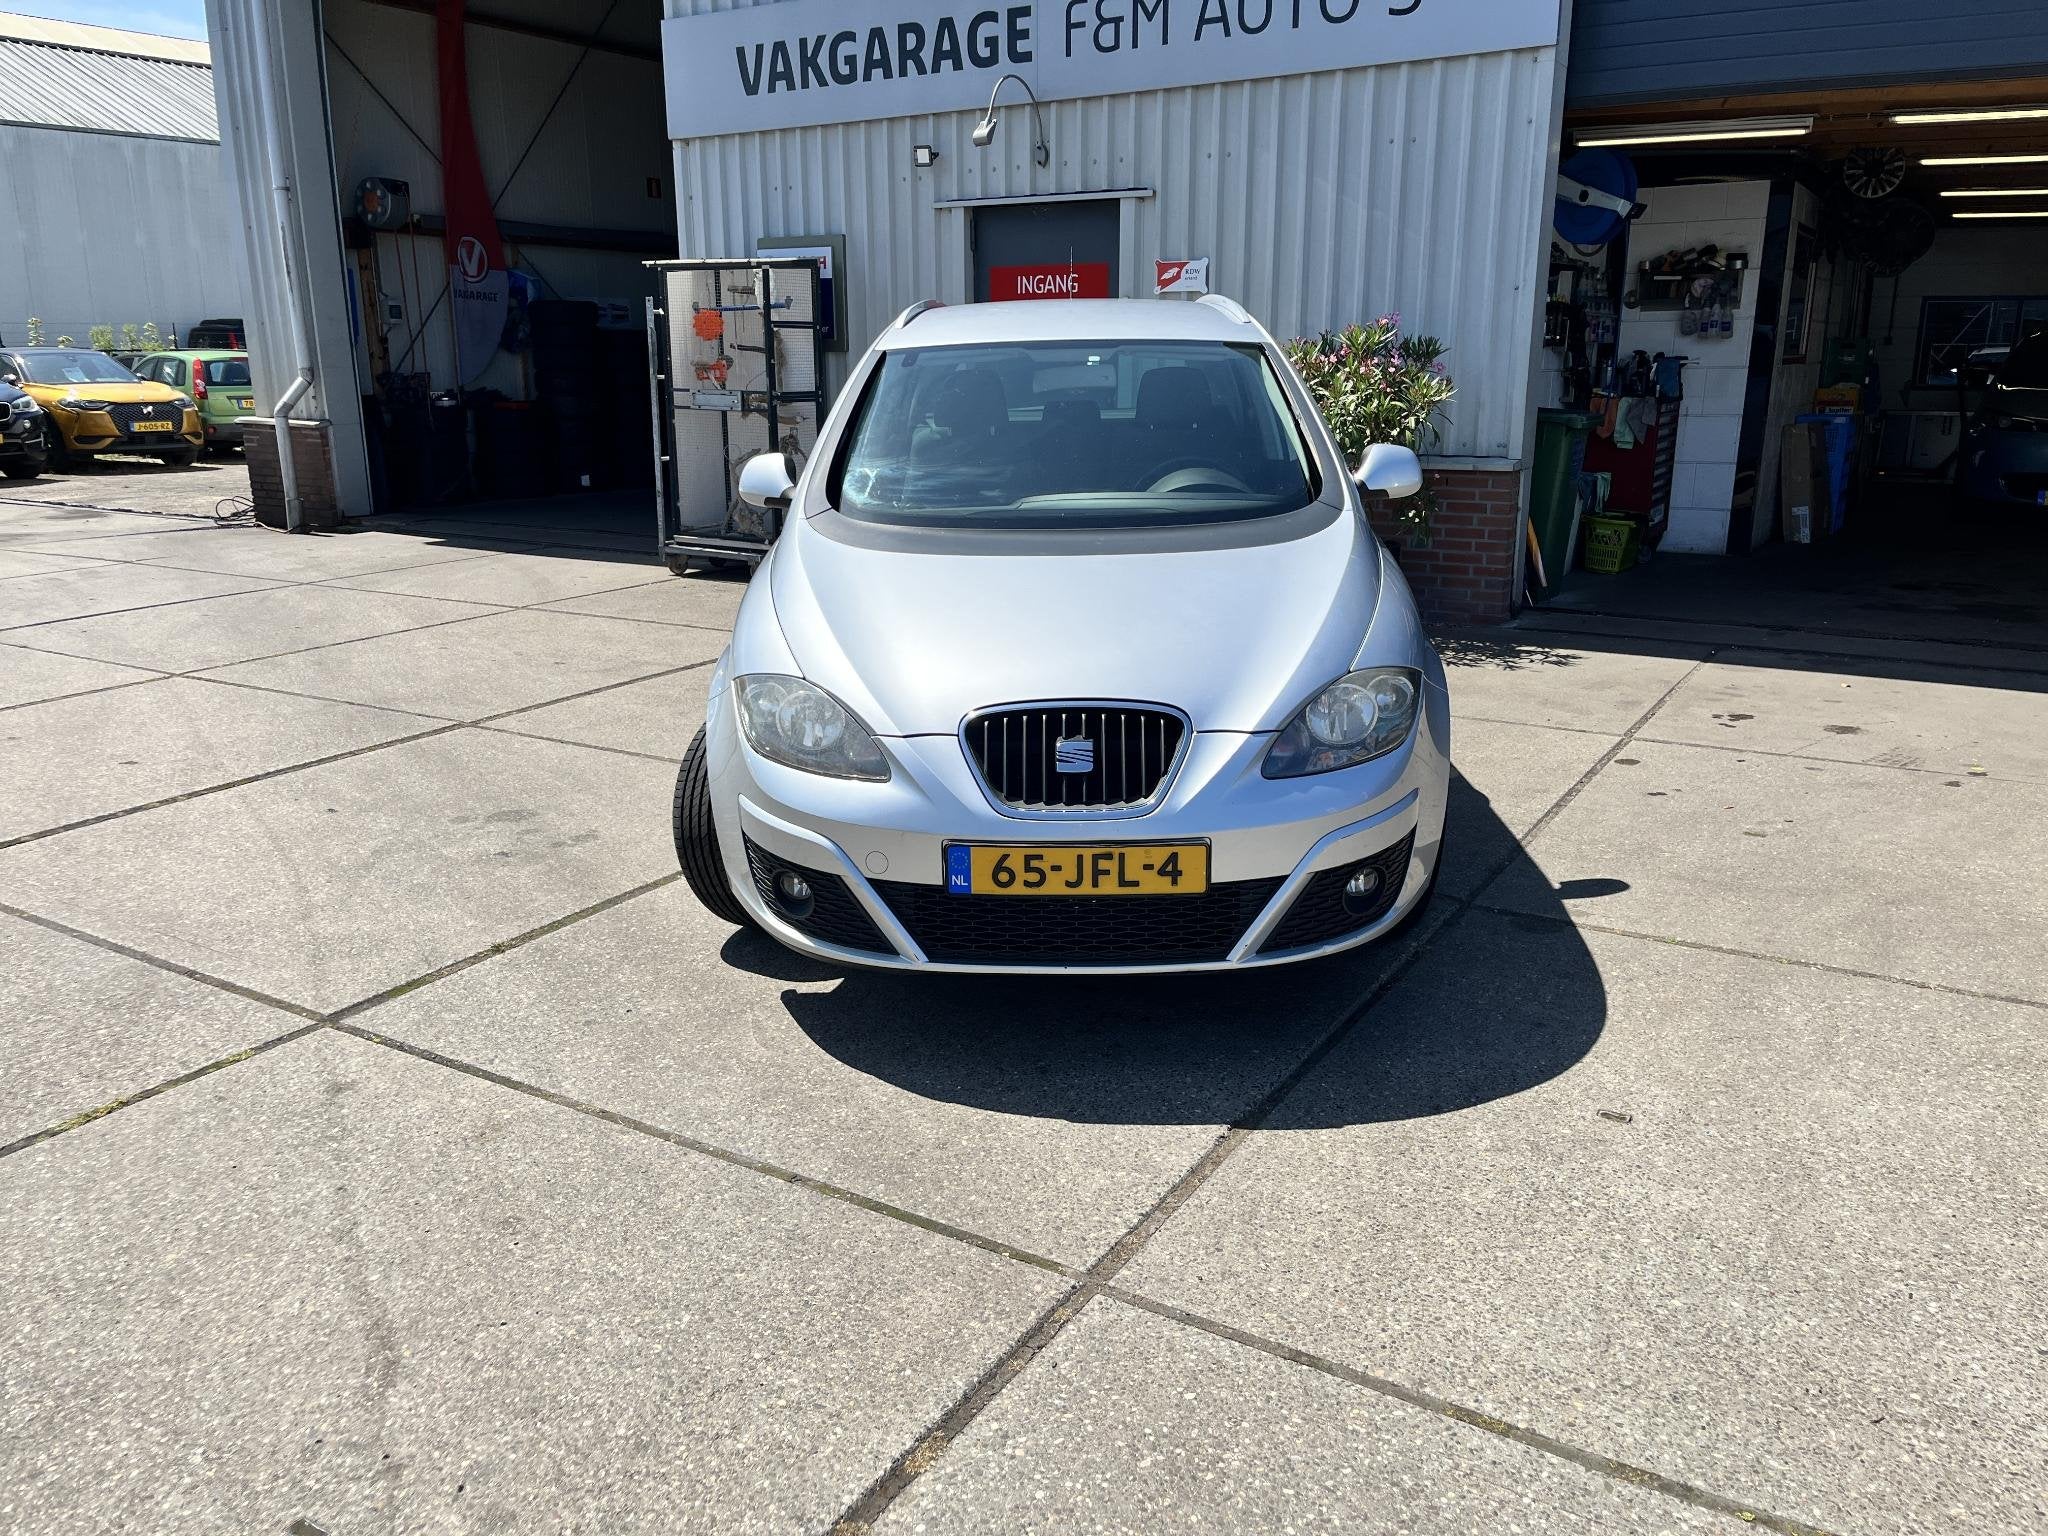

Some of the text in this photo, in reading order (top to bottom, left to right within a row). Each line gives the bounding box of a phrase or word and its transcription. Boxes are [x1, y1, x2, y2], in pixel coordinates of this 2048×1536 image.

[736, 5, 1033, 97] VAKGARAGE
[1065, 0, 1169, 58] F&M
[1017, 273, 1079, 294] INGANG
[951, 874, 969, 887] NL
[991, 851, 1183, 889] 65-JFL-4
